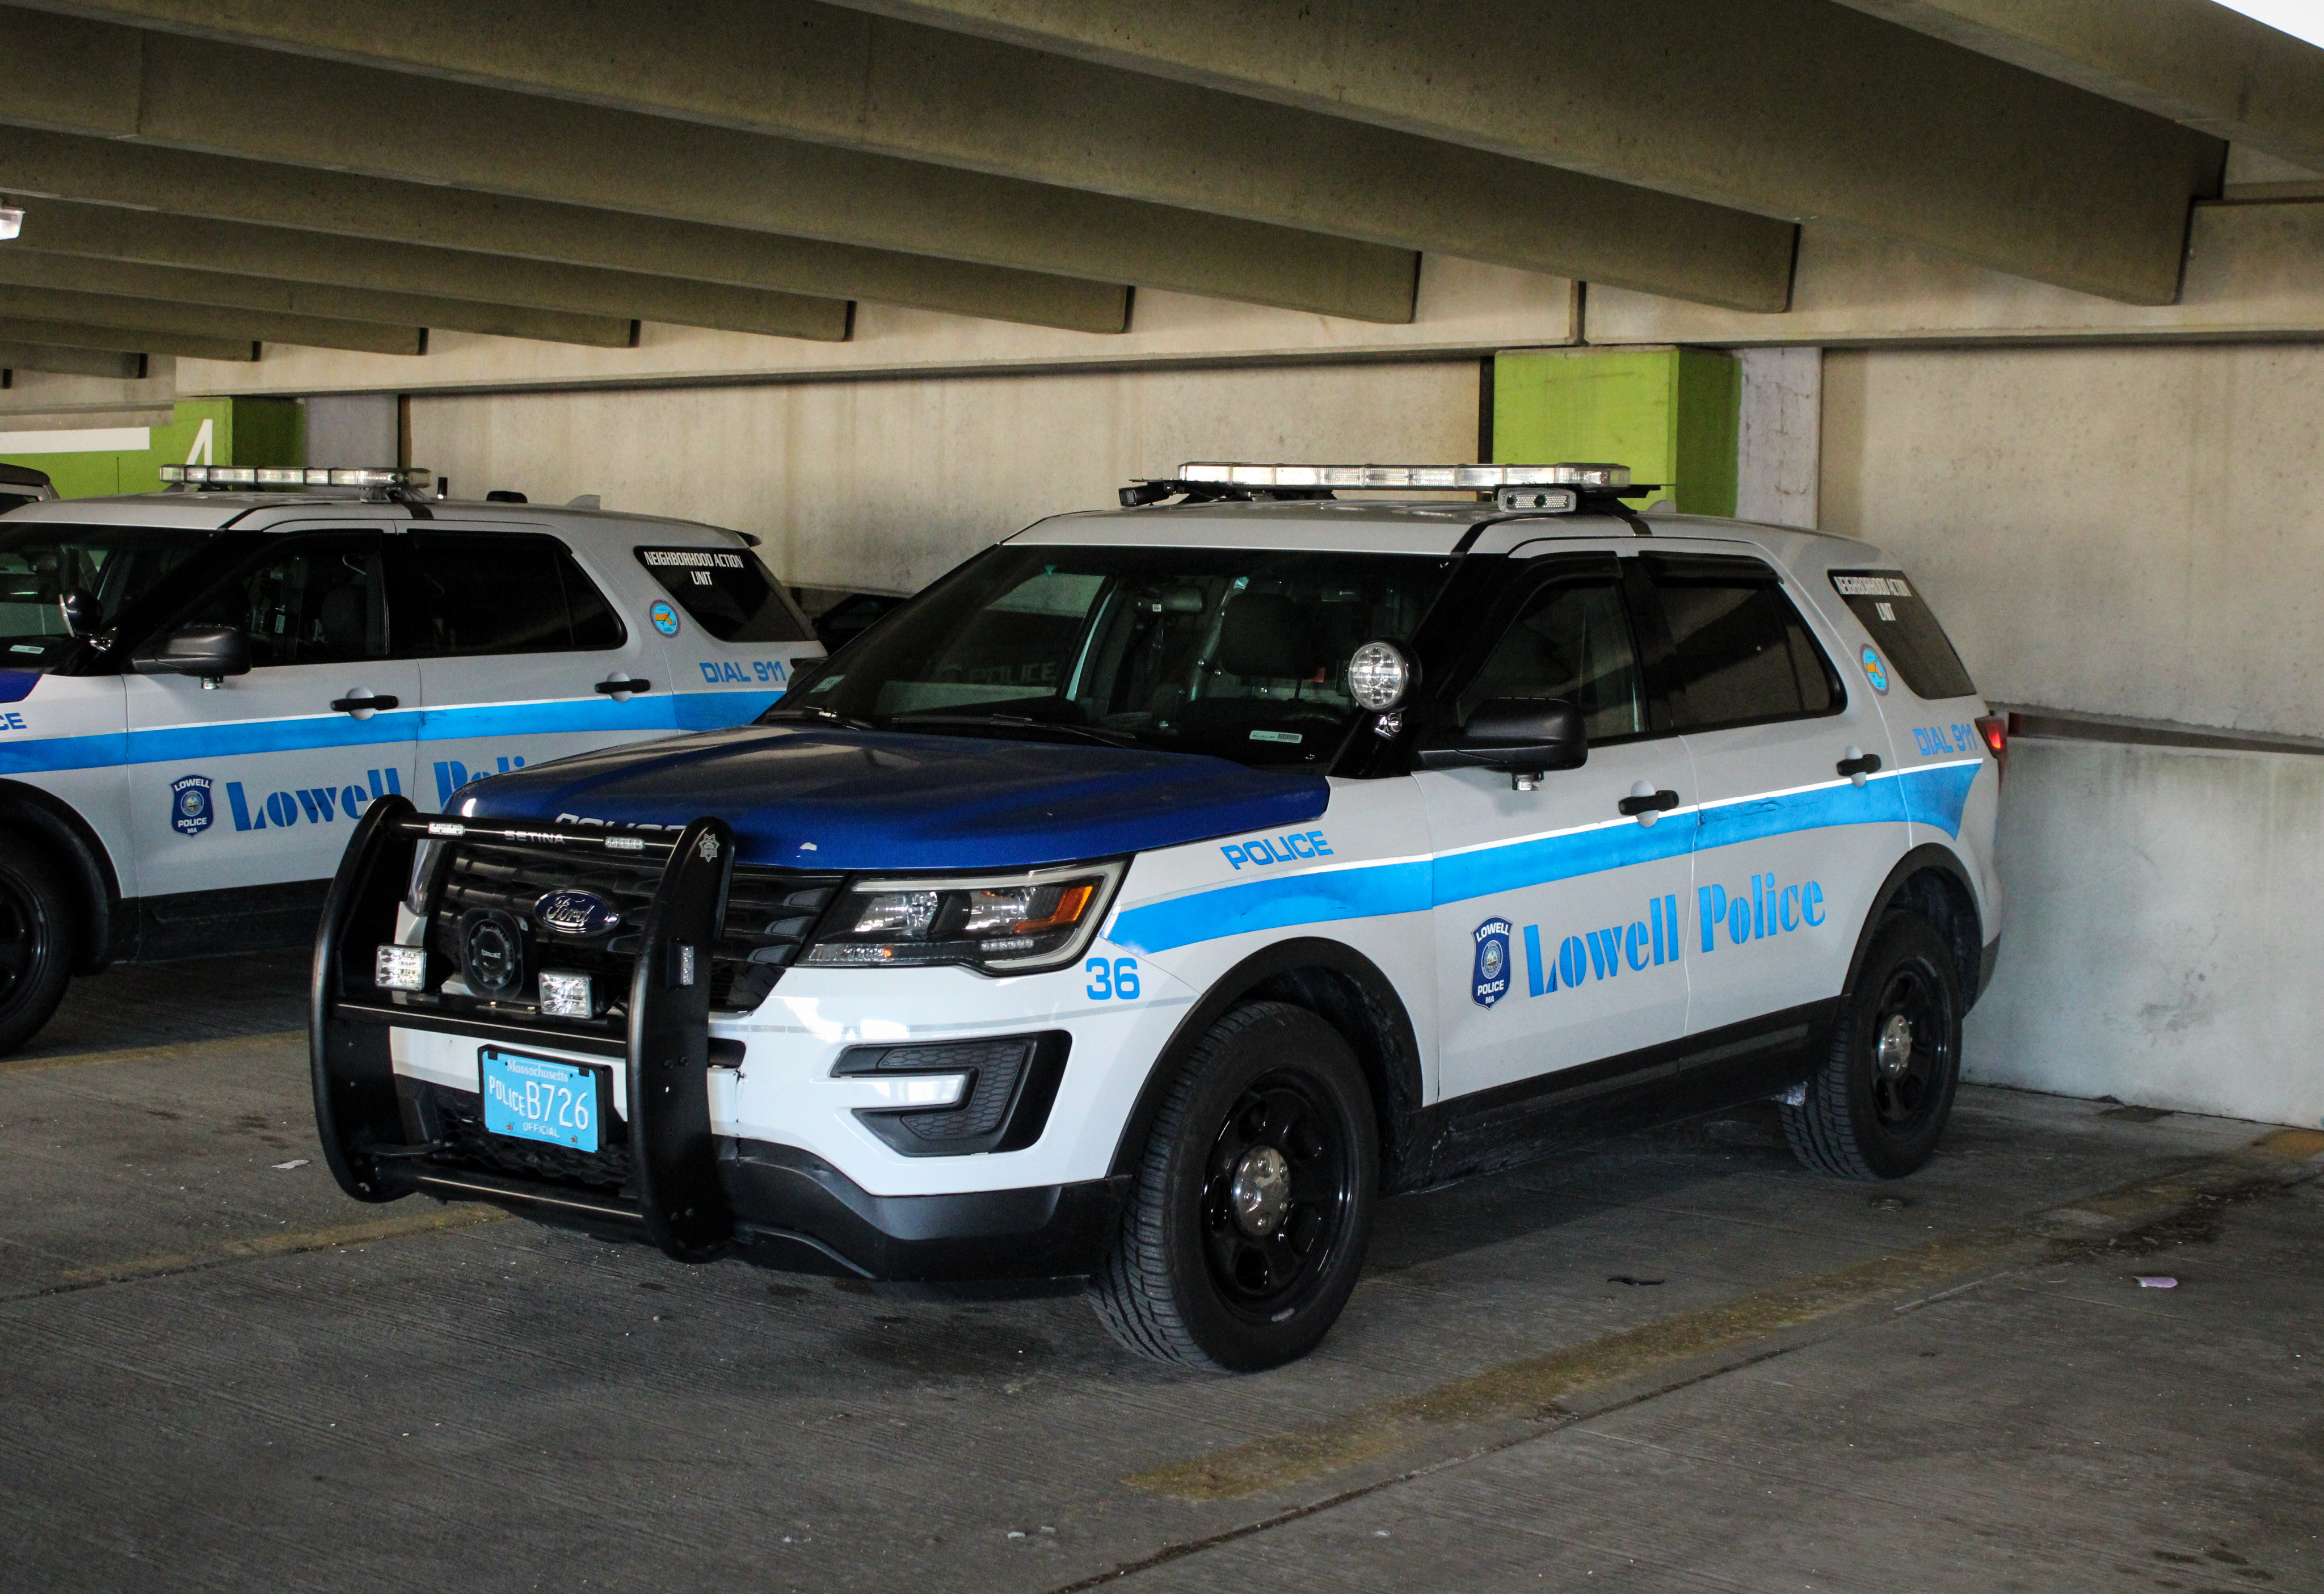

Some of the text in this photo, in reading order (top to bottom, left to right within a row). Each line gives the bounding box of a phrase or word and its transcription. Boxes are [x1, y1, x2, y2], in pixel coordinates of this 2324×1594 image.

[644, 551, 744, 569] NEIGHBORHOOD ACTION
[691, 571, 713, 585] UNIT
[1875, 602, 1896, 621] UNIT
[699, 661, 786, 683] DIAL 911
[1913, 724, 1978, 756] DIAL 911
[174, 779, 210, 792] LOWELL
[226, 768, 402, 832] Lowell
[178, 817, 207, 828] POLICE
[504, 830, 566, 844] SETINA
[1220, 830, 1333, 870] POLICE
[546, 895, 595, 923] Ford
[1476, 922, 1509, 942] LOWELL
[1523, 872, 1826, 998] Lowell Police
[1085, 957, 1140, 1000] 36
[1477, 979, 1505, 996] POLICE
[1485, 995, 1495, 1004] MA
[506, 1059, 569, 1083] Massachusetts
[489, 1075, 589, 1130] POLICE B726
[523, 1122, 561, 1138] OFFICIAL
